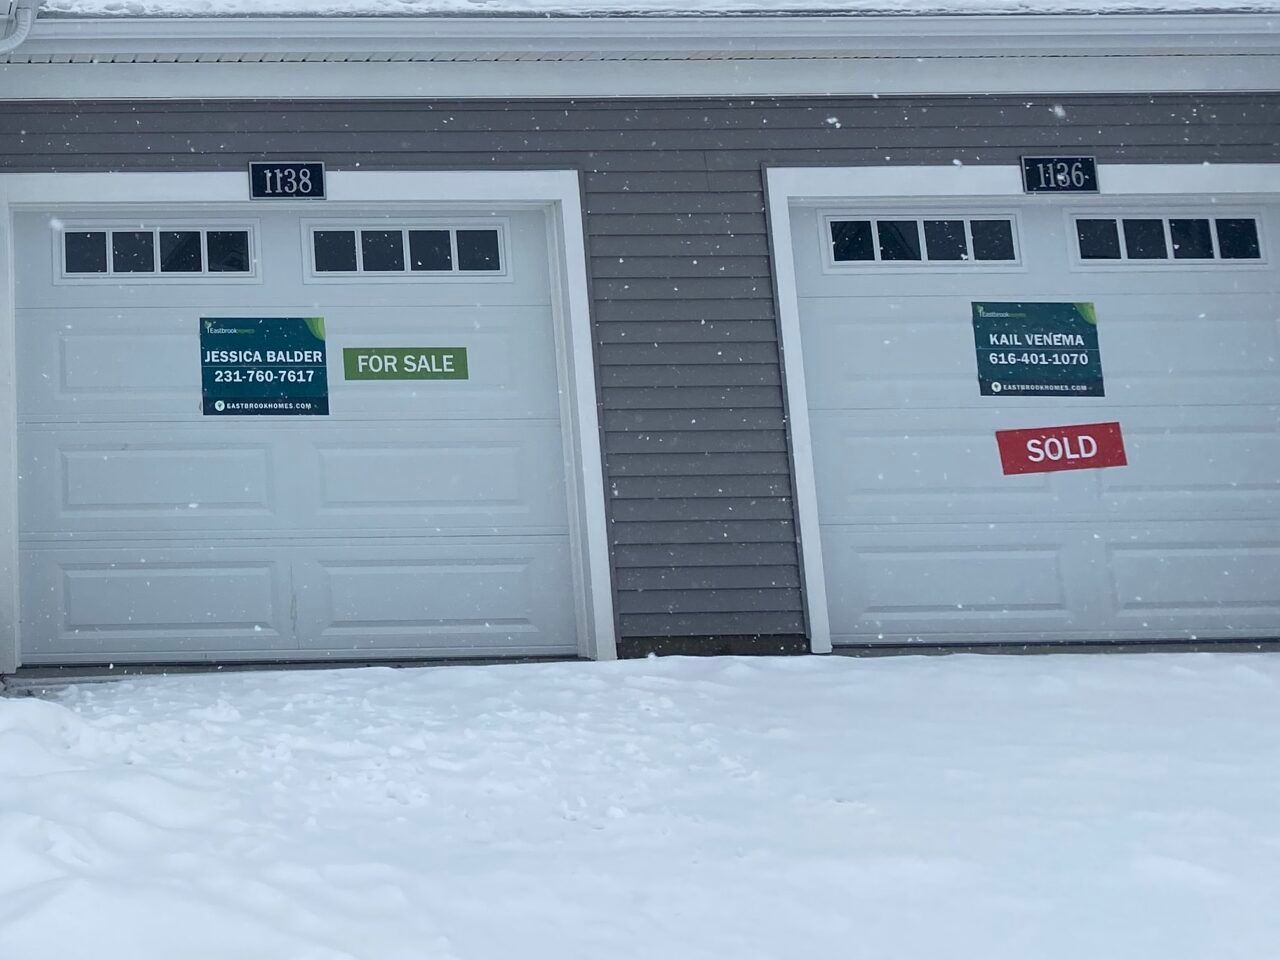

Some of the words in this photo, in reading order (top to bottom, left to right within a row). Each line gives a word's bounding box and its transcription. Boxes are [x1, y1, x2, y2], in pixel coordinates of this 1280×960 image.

[264, 168, 312, 193] 1138
[1037, 162, 1084, 187] 1136
[989, 333, 1022, 346] KAIL
[1025, 333, 1085, 346] VENEMA
[204, 350, 263, 363] JESSICA
[266, 350, 323, 363] BALDER
[357, 355, 399, 373] FOR
[403, 354, 455, 373] SALE
[989, 352, 1089, 365] 616-401-1070
[214, 370, 315, 383] 231-760-7617
[1026, 435, 1098, 462] SOLD
